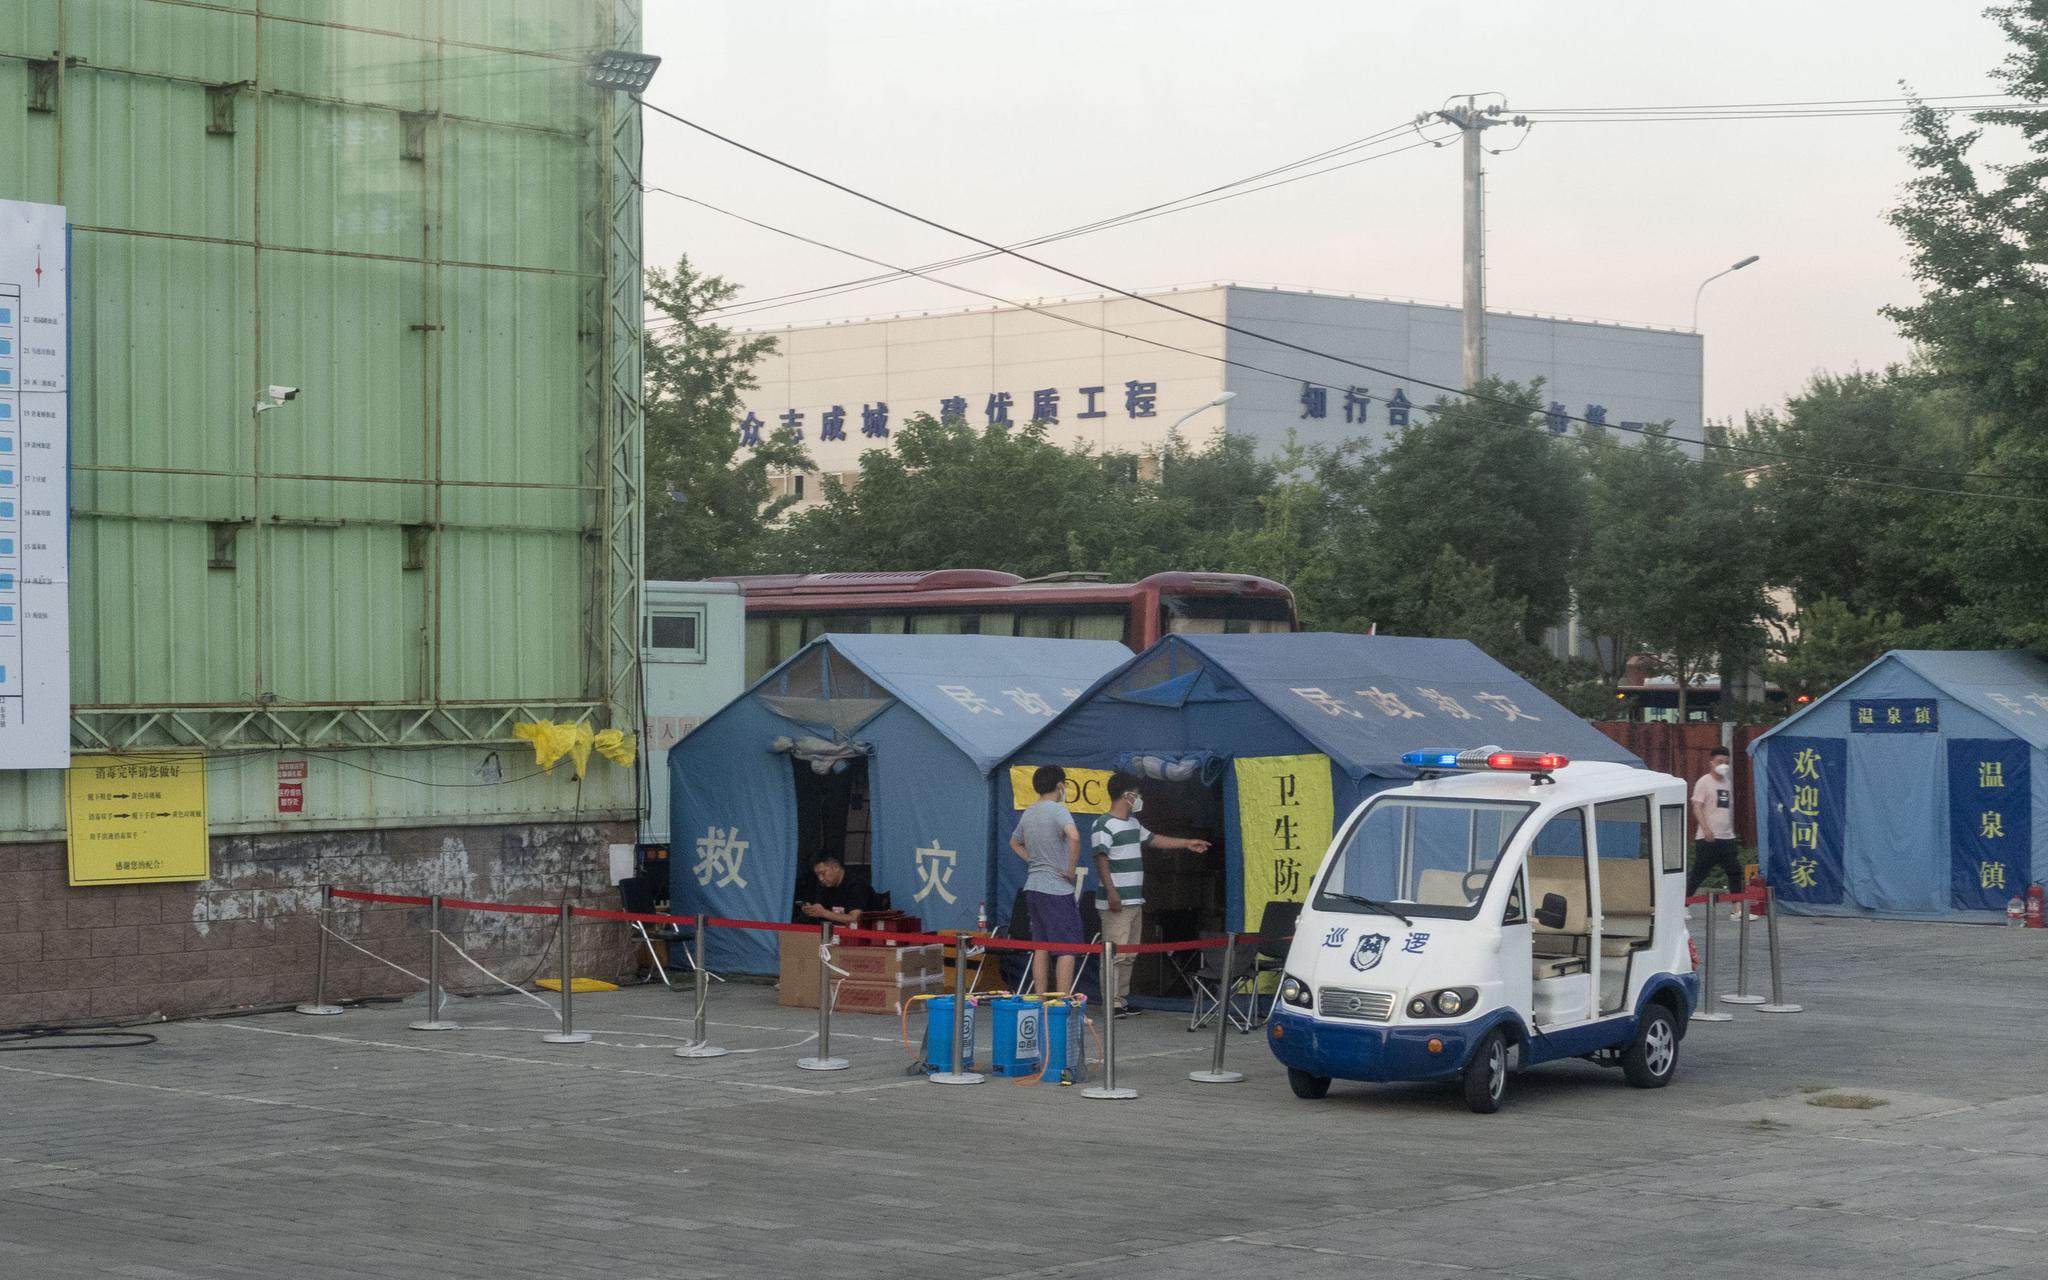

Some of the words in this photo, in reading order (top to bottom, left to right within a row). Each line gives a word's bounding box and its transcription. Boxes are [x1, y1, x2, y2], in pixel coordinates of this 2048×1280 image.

[937, 684, 1083, 717] 民政
[1858, 706, 1931, 725] 温泉镇
[1063, 778, 1101, 806] DC
[1790, 748, 1822, 888] 欢迎回家
[1272, 773, 1302, 903] 卫生防
[1978, 761, 2006, 890] 温泉镇
[693, 826, 750, 889] 救
[913, 839, 957, 905] 灾
[1322, 927, 1349, 948] 巡
[1401, 932, 1430, 954] 逻
